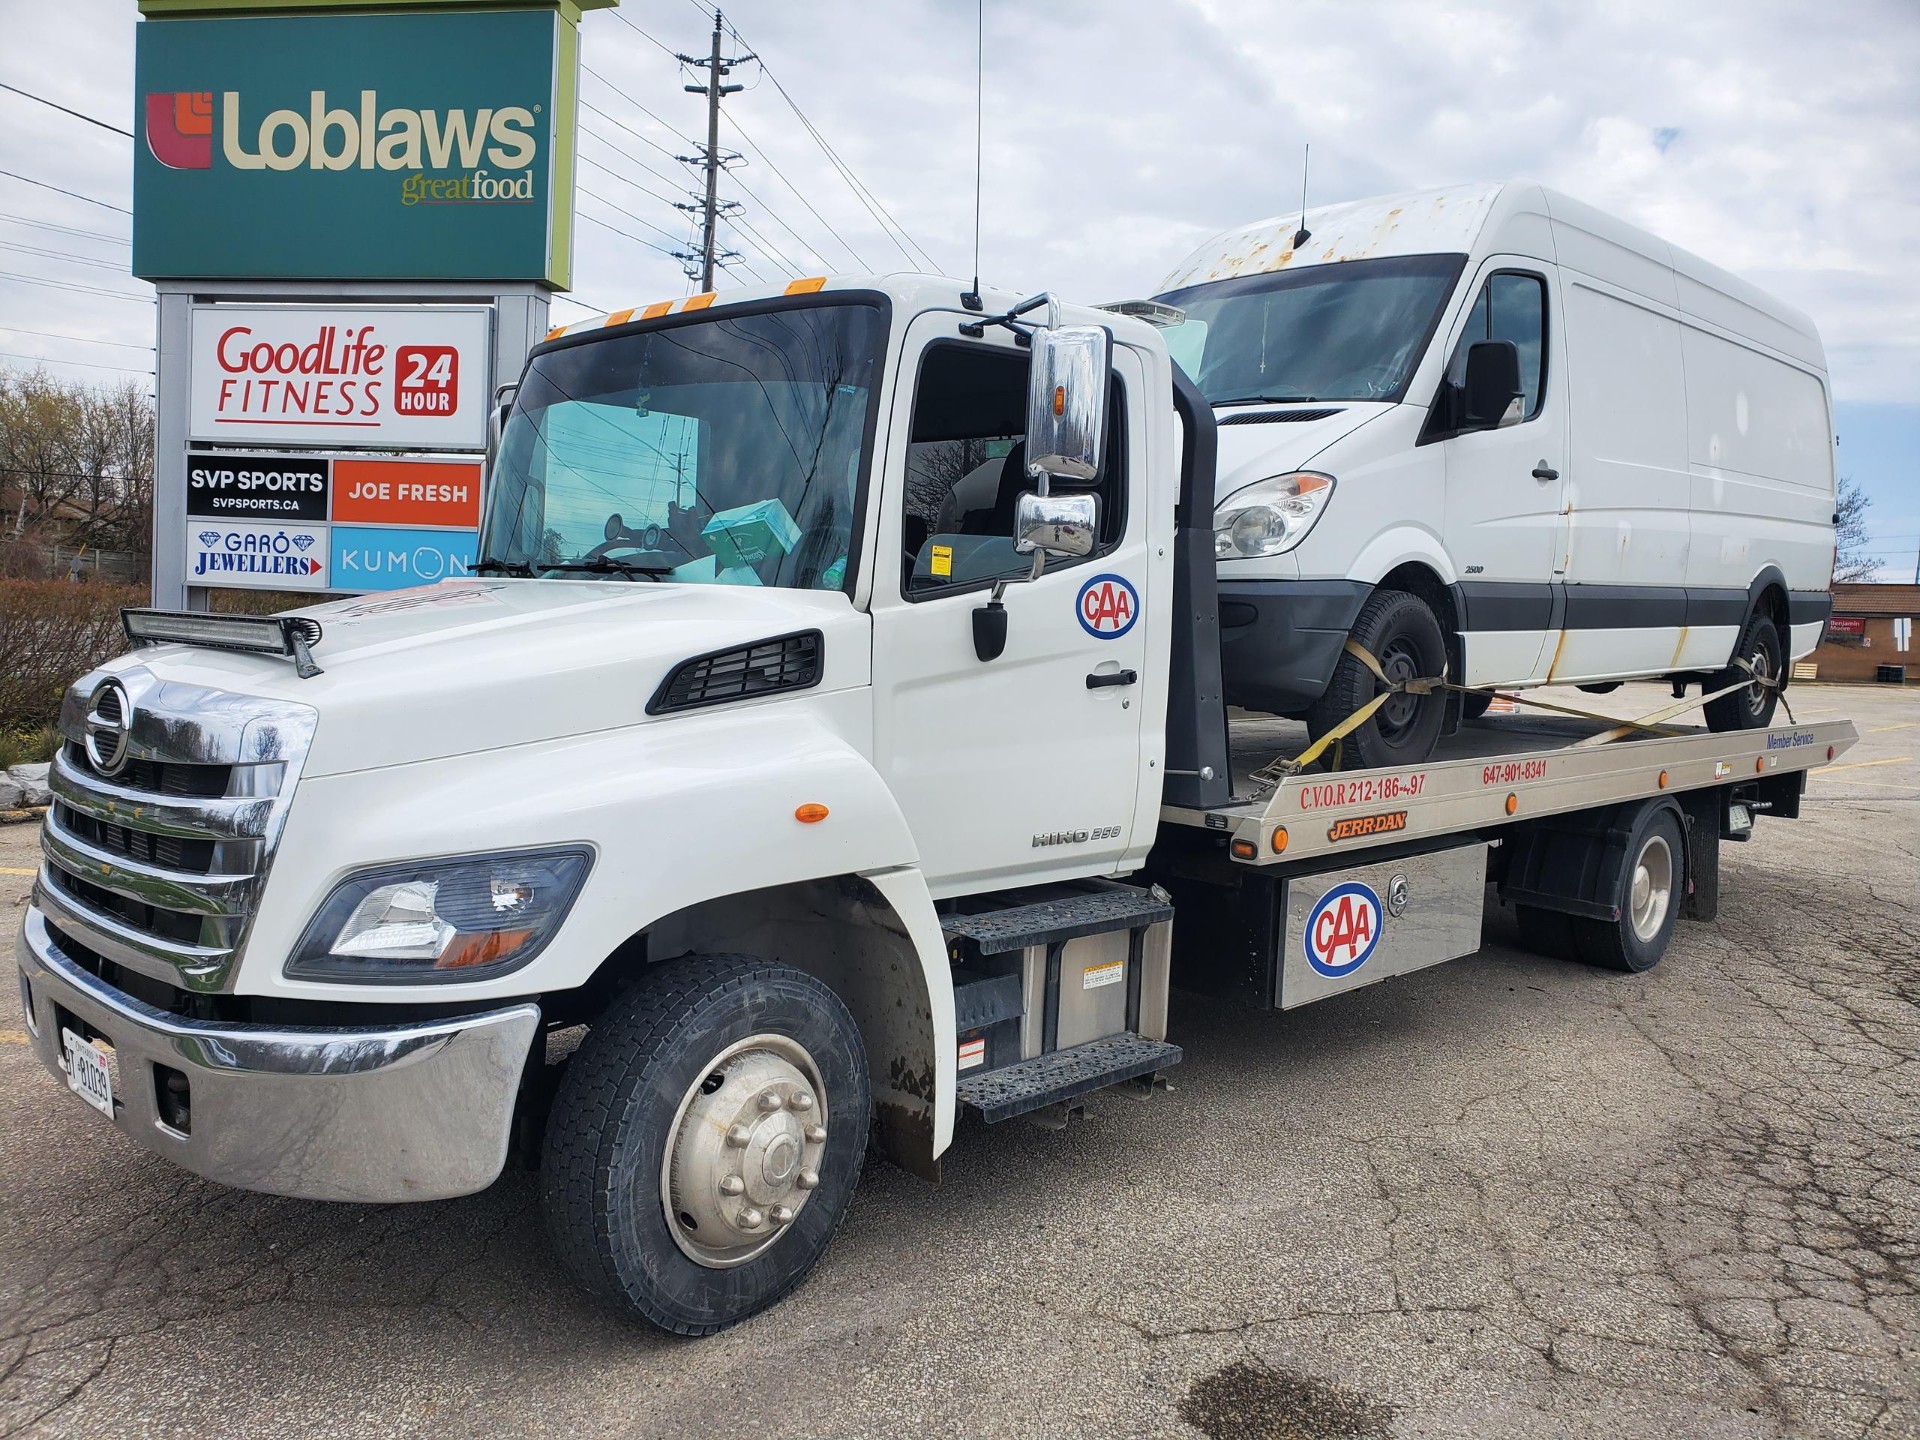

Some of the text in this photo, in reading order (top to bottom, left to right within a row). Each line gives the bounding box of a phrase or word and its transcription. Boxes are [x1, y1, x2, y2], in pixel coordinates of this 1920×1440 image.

[222, 89, 537, 171] Loblaws
[402, 353, 452, 388] 24
[218, 379, 382, 416] FITNESS
[401, 392, 449, 411] HOUR
[191, 469, 323, 493] SVP SPORTS
[349, 482, 468, 503] JOE FRESH
[212, 497, 300, 511] SVPSPORTS.CA
[341, 546, 469, 580] KUMON
[1464, 565, 1484, 574] 2500
[1084, 582, 1130, 629] CAA
[1766, 731, 1814, 750] Member Service
[1483, 760, 1547, 785] 647-901-8341
[1032, 825, 1121, 848] HINO 258
[1315, 896, 1371, 965] CAA
